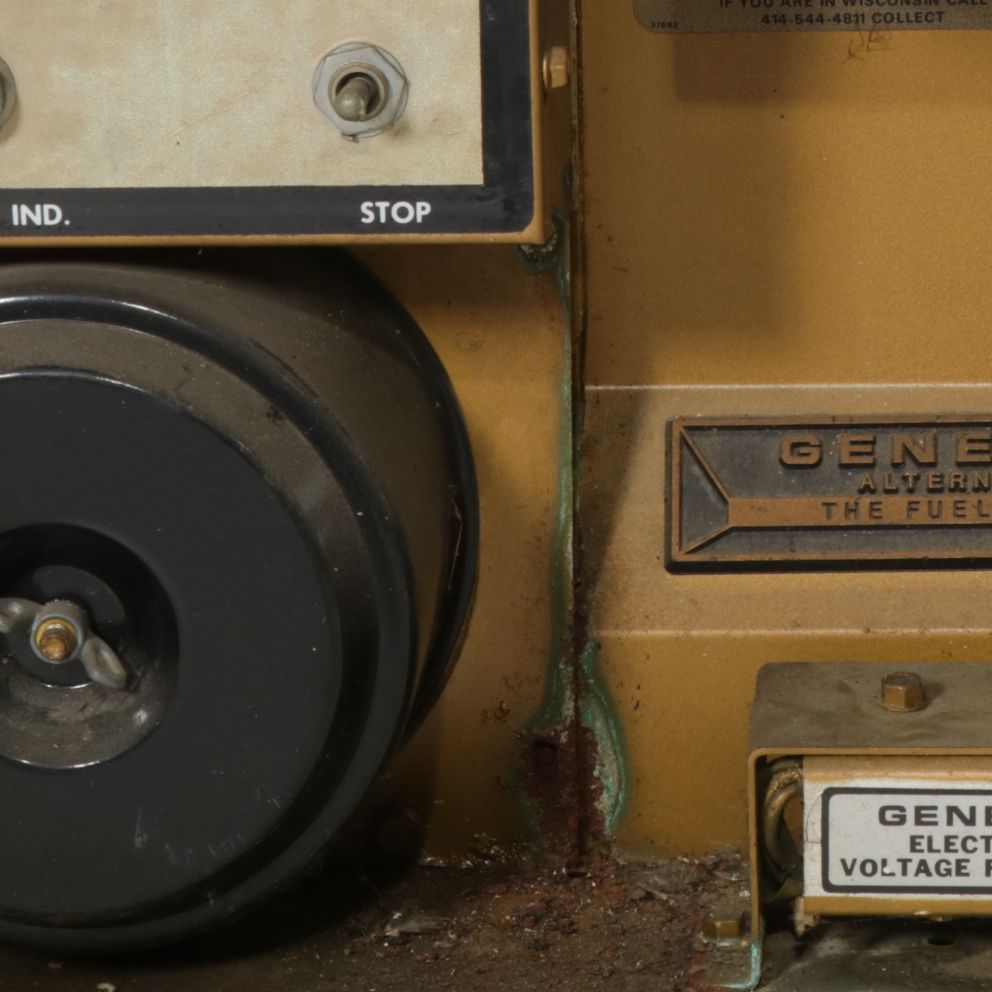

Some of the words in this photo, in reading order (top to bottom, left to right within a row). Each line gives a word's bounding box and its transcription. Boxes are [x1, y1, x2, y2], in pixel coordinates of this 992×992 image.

[762, 12, 864, 28] 414-544-4811
[871, 11, 945, 27] COLLECT
[12, 204, 70, 226] IND.
[360, 201, 432, 225] STOP
[822, 500, 884, 520] THE
[906, 498, 990, 519] FUEL
[840, 858, 970, 878] VOLTAGE
